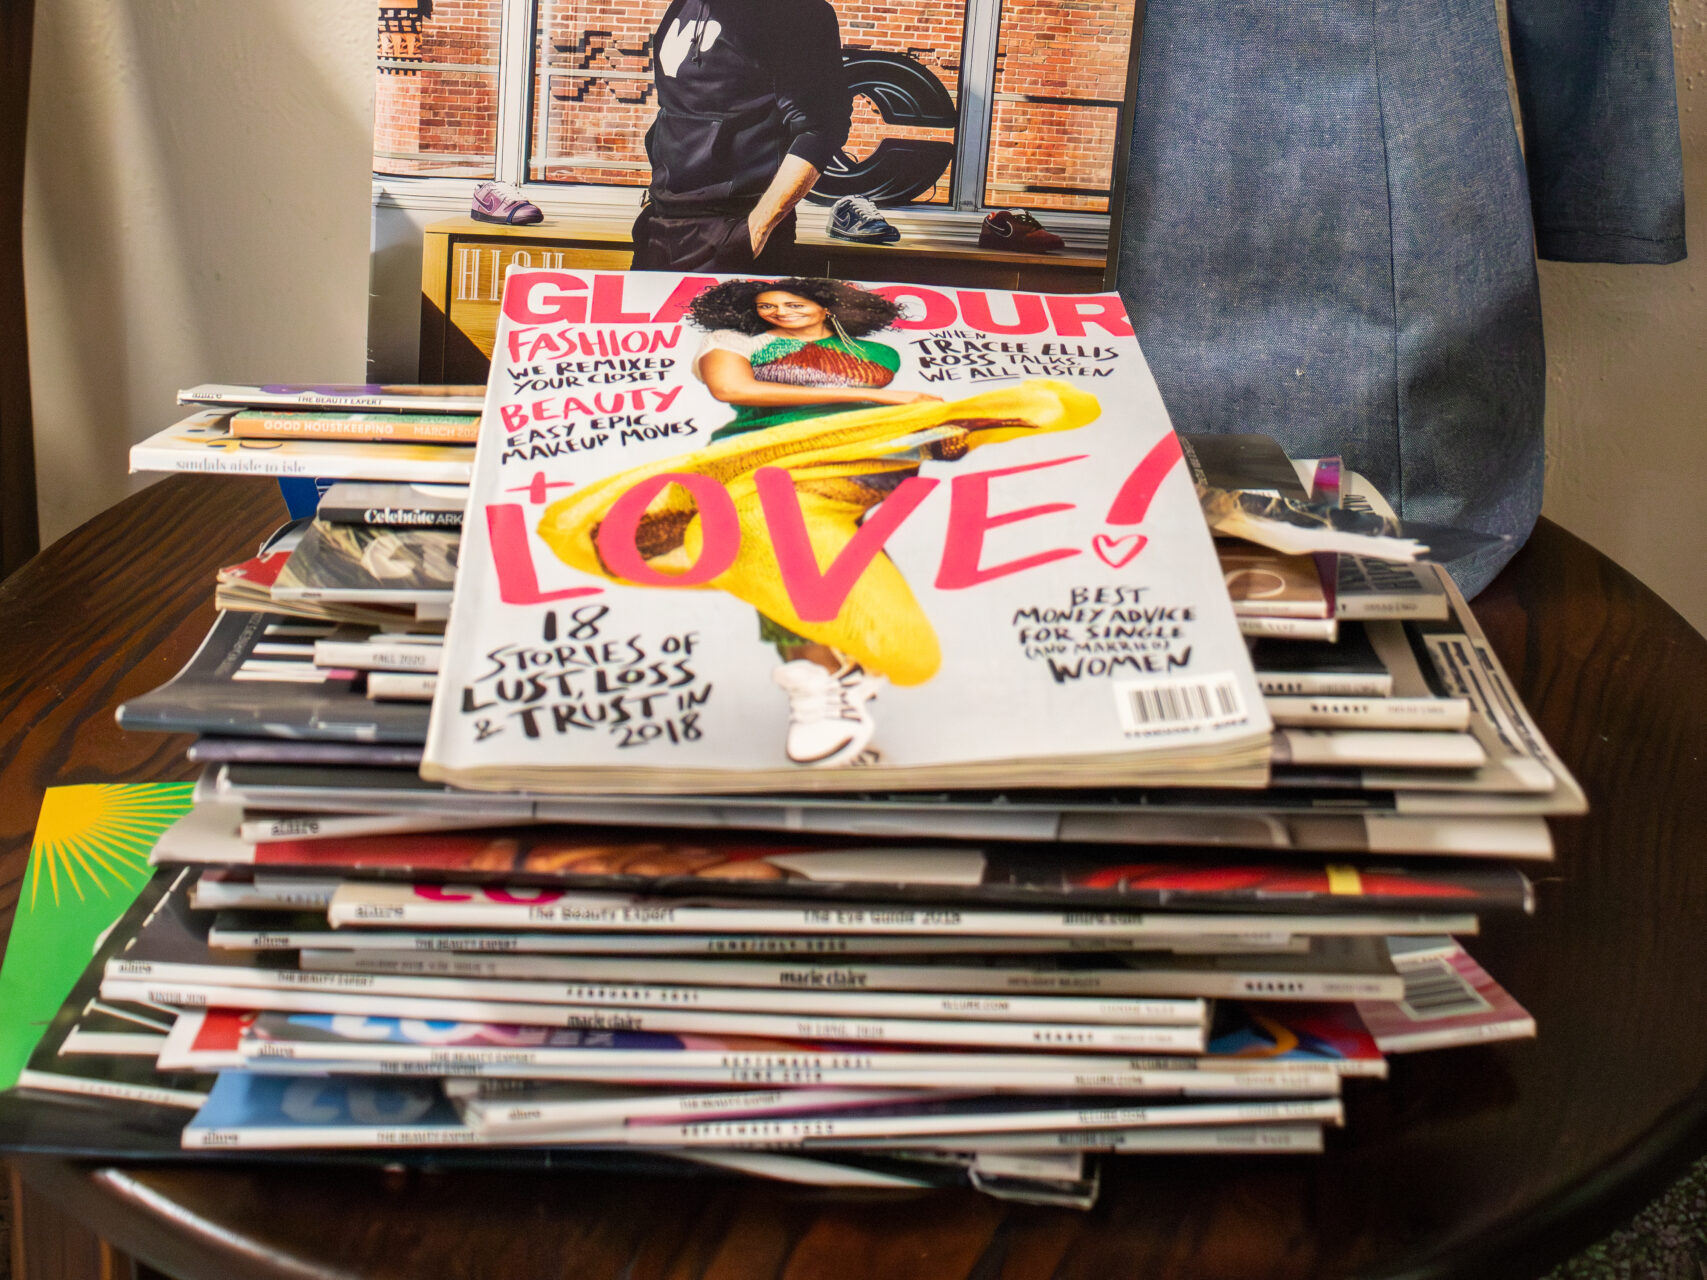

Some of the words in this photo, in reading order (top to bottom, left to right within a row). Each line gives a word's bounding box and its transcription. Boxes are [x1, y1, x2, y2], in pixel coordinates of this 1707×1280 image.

[502, 272, 1135, 337] GLAOUR
[507, 325, 682, 363] FASHION
[909, 338, 1029, 355] TRACEE
[1041, 343, 1119, 361] ELLIS
[929, 330, 986, 339] WHEN
[507, 365, 546, 380] WE
[556, 358, 675, 376] REMIXED
[919, 353, 996, 368] ROSS
[919, 369, 961, 382] WE
[970, 367, 1020, 380] ALL
[1023, 365, 1115, 377] LISTEN
[513, 375, 583, 395] YOUR
[588, 371, 671, 384] CLOSET
[500, 385, 684, 433] BEAUTY
[264, 420, 300, 431] GOOD
[304, 421, 394, 435] HOUSEKEEPING
[413, 425, 455, 437] MARCH
[457, 428, 478, 438] 202
[501, 434, 609, 465] MAKEUP
[621, 418, 698, 446] MOVES
[507, 423, 575, 447] EASY
[591, 414, 647, 430] EPIC
[364, 507, 435, 524] Celebrate
[486, 431, 1184, 623] LOVE!
[1071, 586, 1150, 607] BEST
[543, 606, 609, 641] 18
[1012, 606, 1104, 625] MONEY
[1111, 606, 1197, 624] ADVICE
[1019, 627, 1072, 644] FOR
[1086, 626, 1184, 639] SINGLE
[475, 635, 646, 683] STORIES
[661, 632, 699, 654] OF
[1049, 645, 1192, 684] WOMEN
[461, 669, 590, 713] LUST,
[595, 660, 696, 695] LOSS
[474, 719, 504, 741] &
[509, 693, 670, 738] TRUST
[678, 683, 712, 711] IN
[609, 714, 704, 748] 2018
